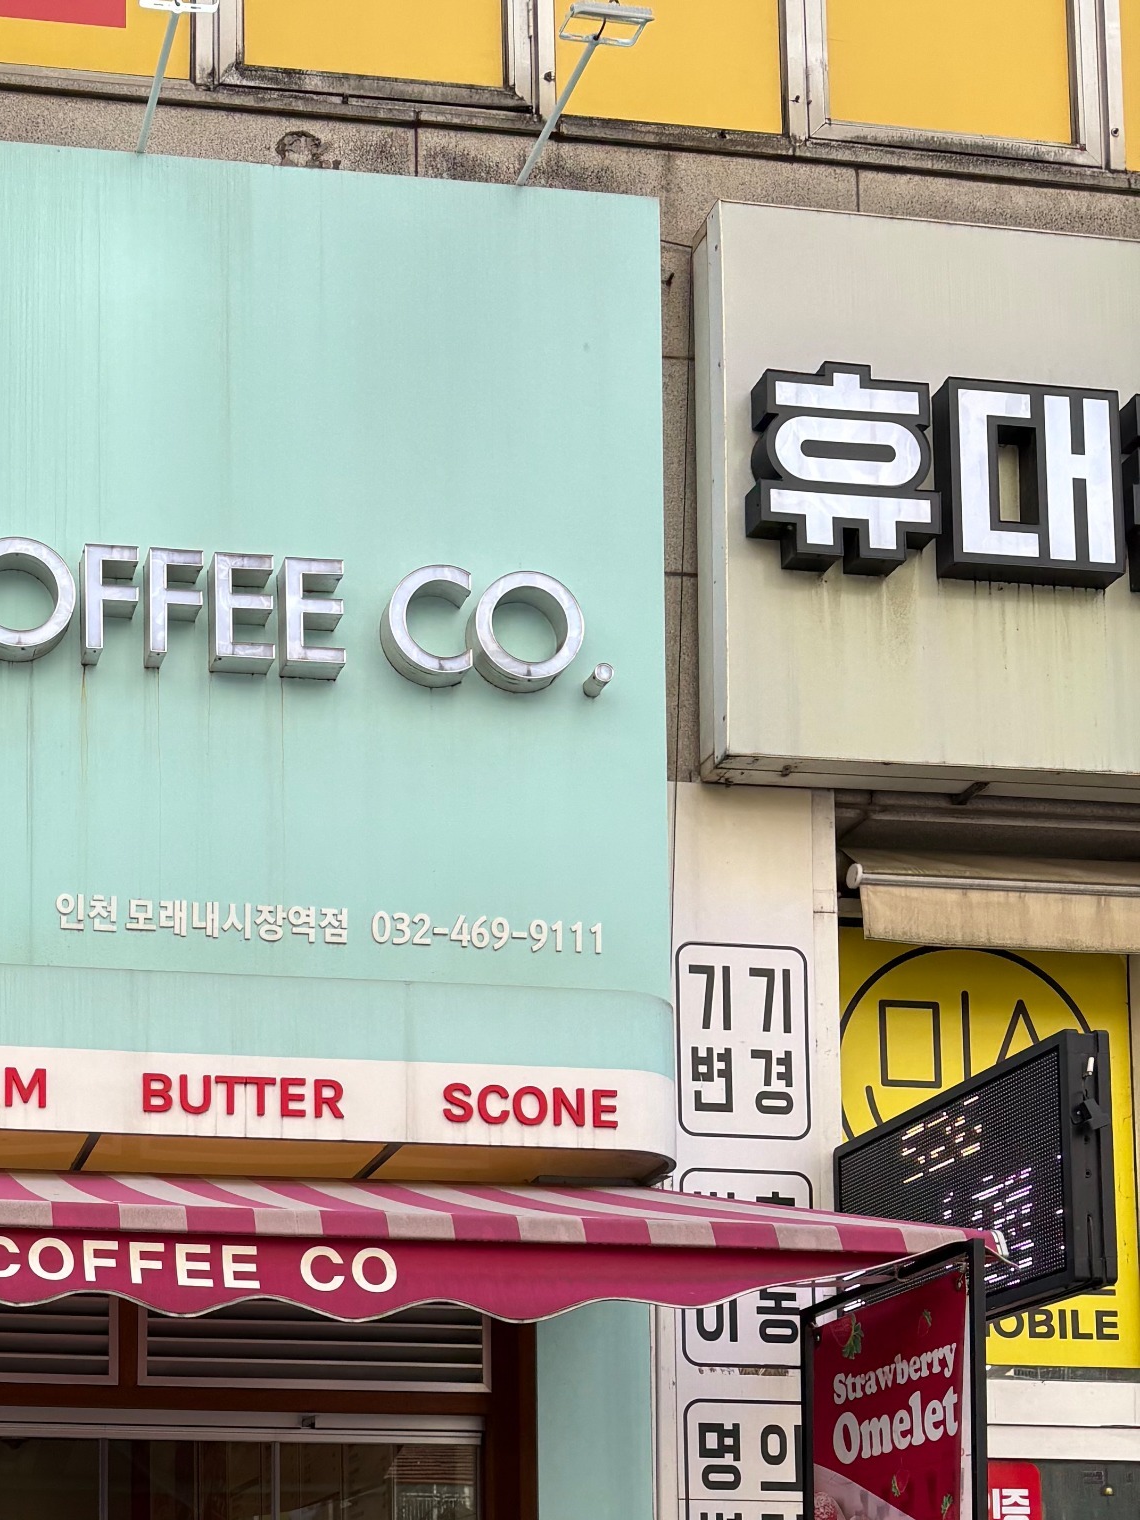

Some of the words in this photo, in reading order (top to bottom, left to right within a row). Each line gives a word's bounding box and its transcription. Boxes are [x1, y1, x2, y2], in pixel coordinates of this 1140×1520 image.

[379, 564, 615, 698] CO.
[55, 892, 118, 933] 인천
[125, 897, 349, 945] 모래내시장역점
[370, 909, 603, 955] 032-469-9111
[688, 964, 791, 1034] 기기
[143, 1072, 345, 1119] BUTTER
[443, 1082, 620, 1129] SCONE
[691, 1046, 793, 1115] 변경
[299, 1246, 398, 1293] CO
[986, 1308, 1120, 1341] OBILE
[833, 1343, 957, 1405] Strawberry
[832, 1386, 958, 1465] Omelet
